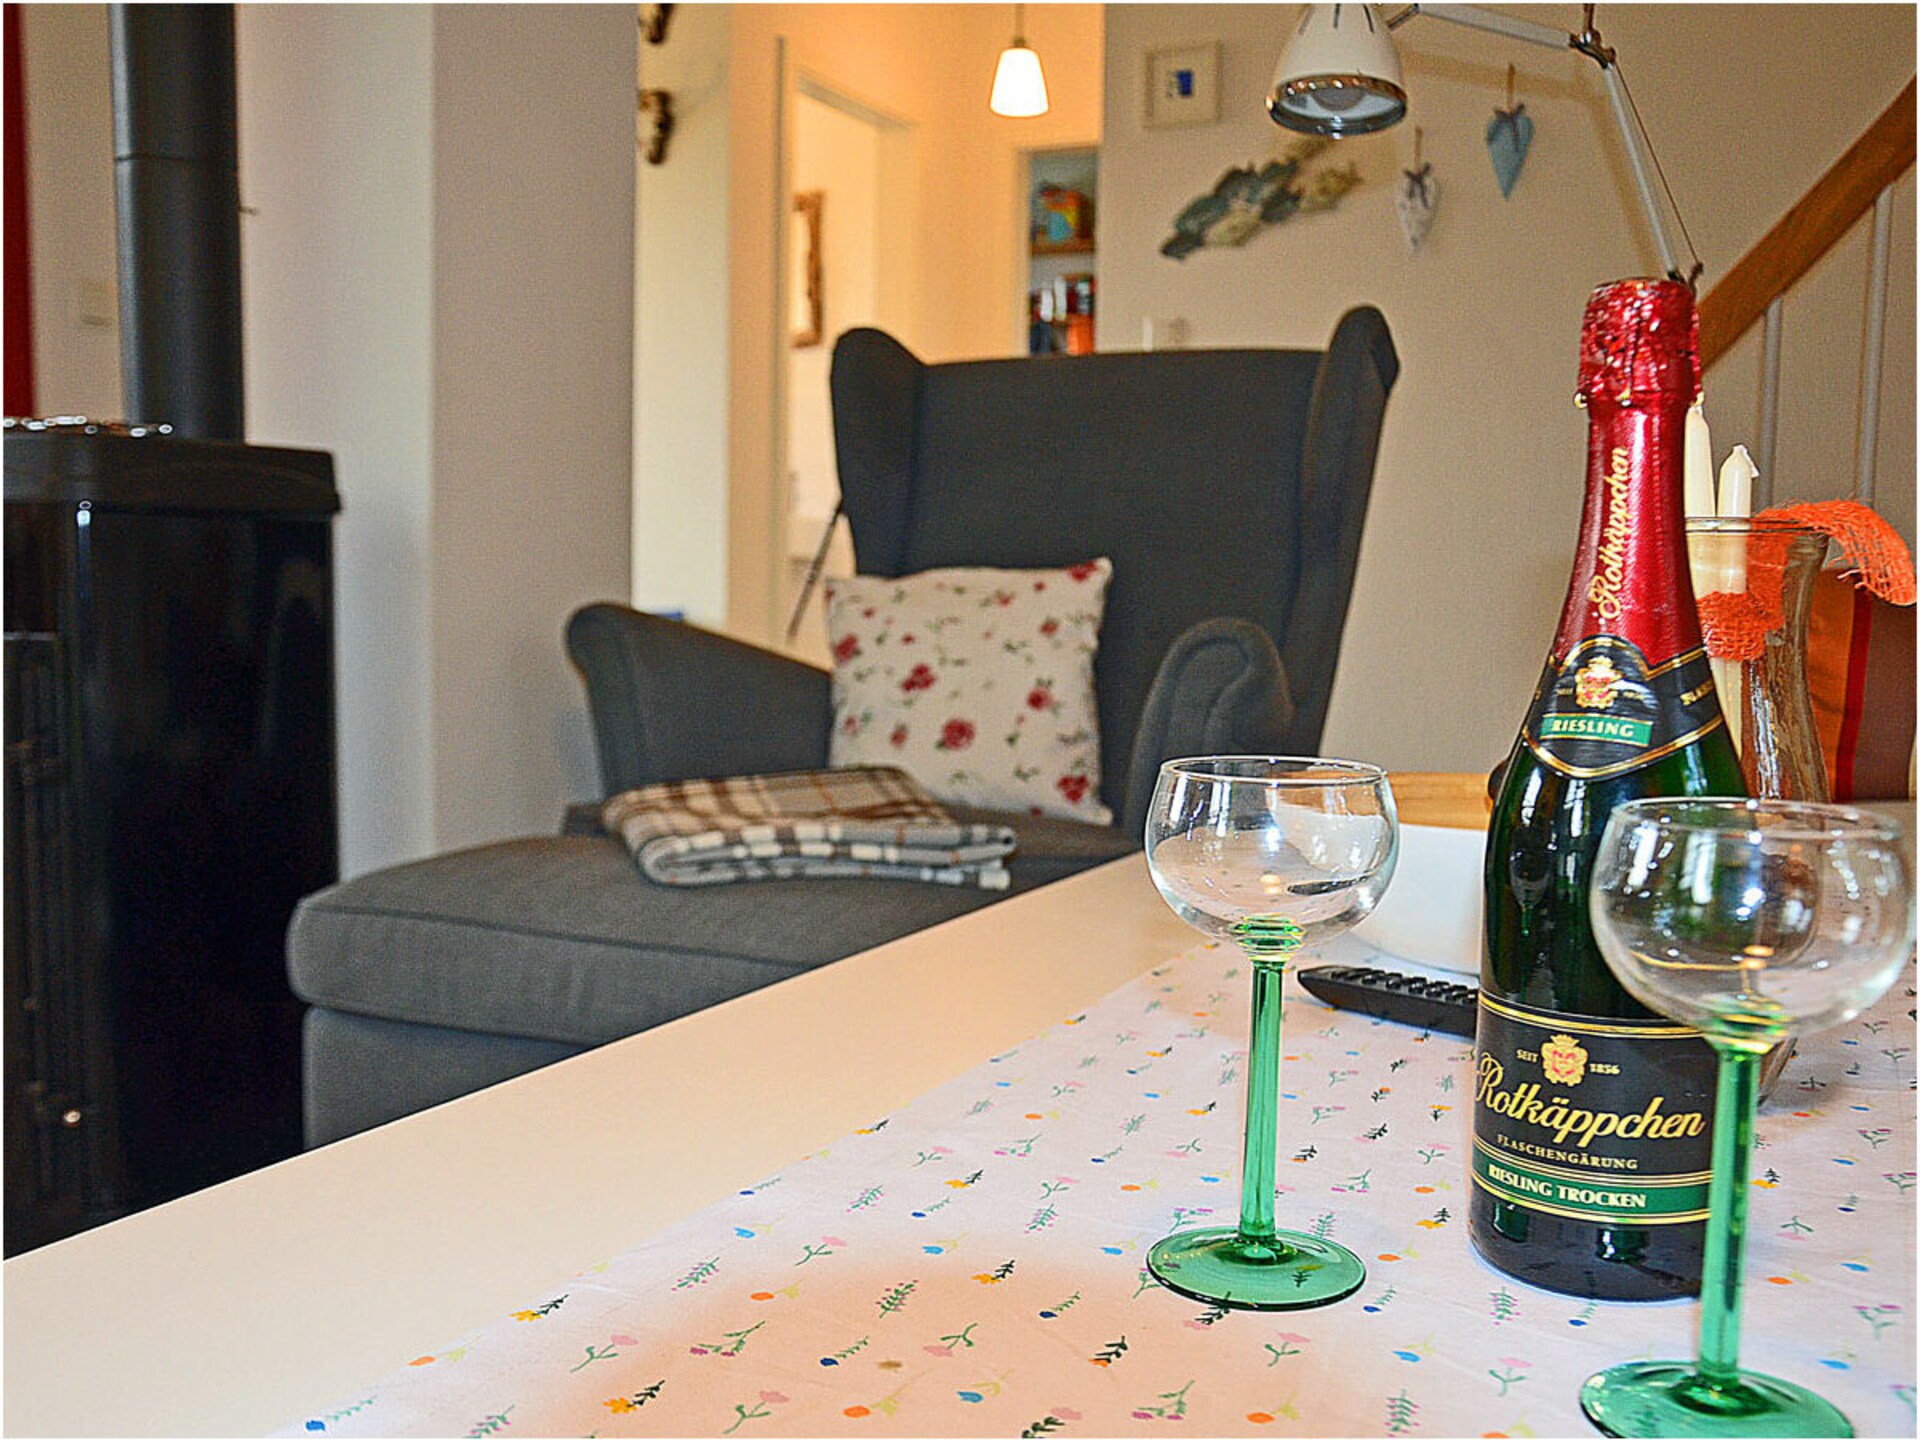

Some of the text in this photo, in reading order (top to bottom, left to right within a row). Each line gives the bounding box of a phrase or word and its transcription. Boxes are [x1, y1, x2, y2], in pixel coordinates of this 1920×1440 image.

[1551, 719, 1635, 737] RIESLING
[1516, 1049, 1620, 1075] SEIT 1856
[1476, 1052, 1705, 1148] Rotkäppchen
[1497, 1133, 1638, 1170] FLASCHENGÄRUNG
[1488, 1164, 1646, 1208] RIESLING TROCKEN
